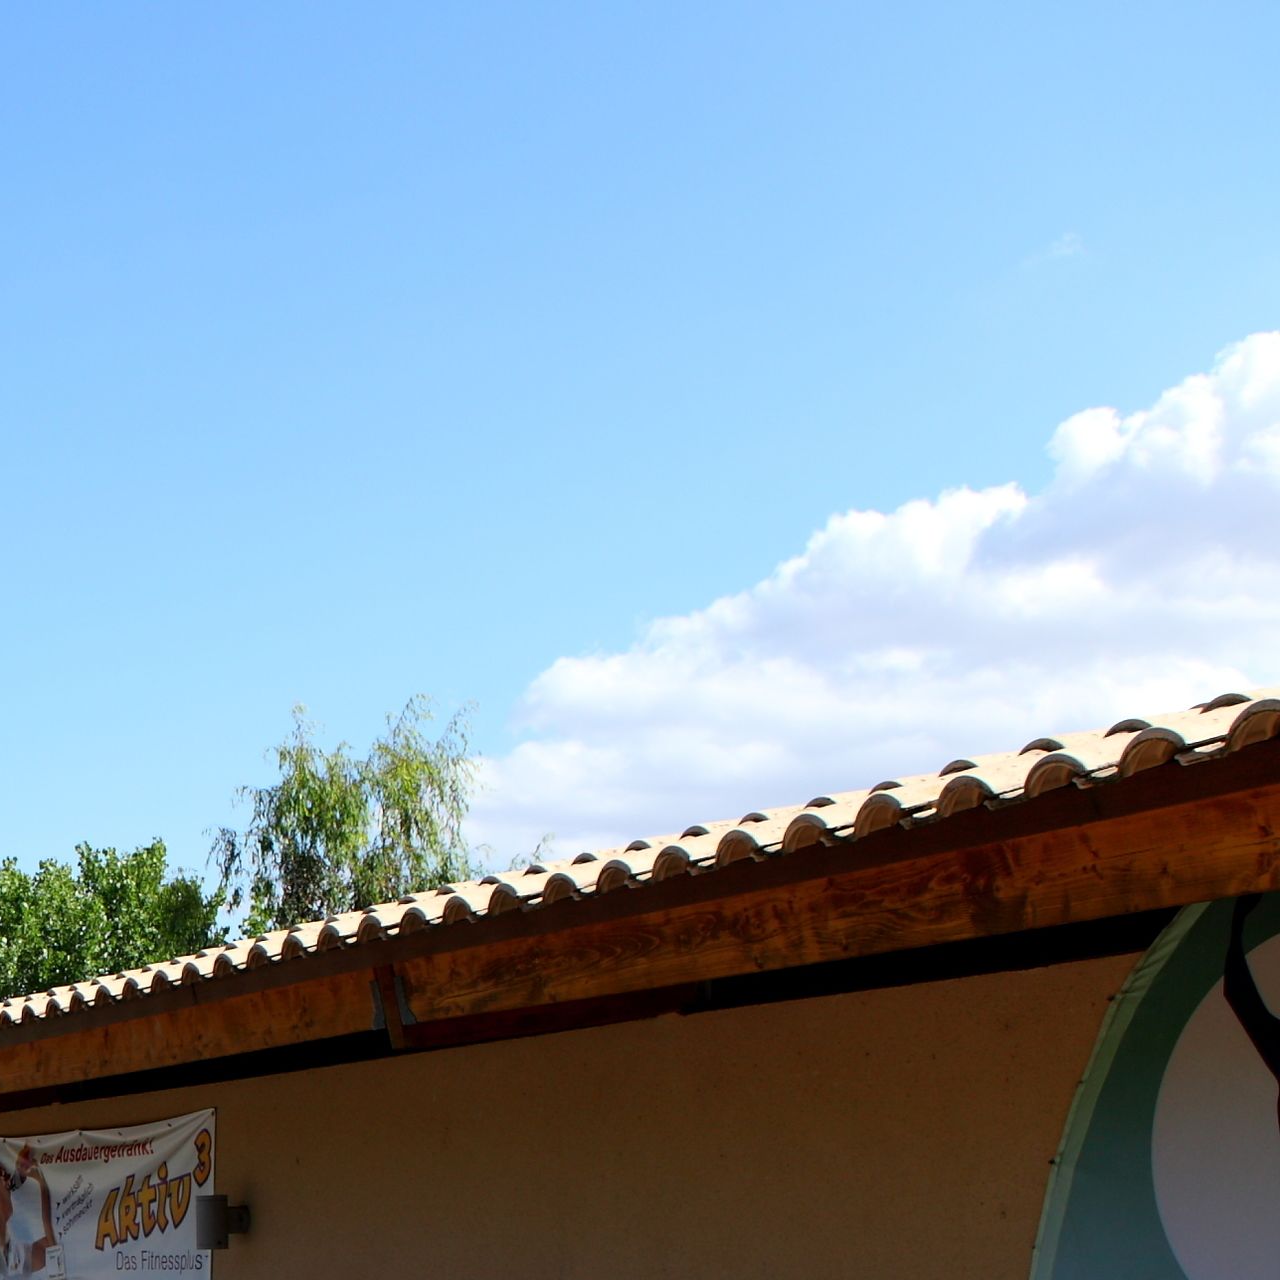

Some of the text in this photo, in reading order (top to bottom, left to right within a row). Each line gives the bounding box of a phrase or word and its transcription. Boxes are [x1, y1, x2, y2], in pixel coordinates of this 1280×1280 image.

[40, 1153, 54, 1164] Das
[116, 1250, 203, 1275] Das Fitnessplus
